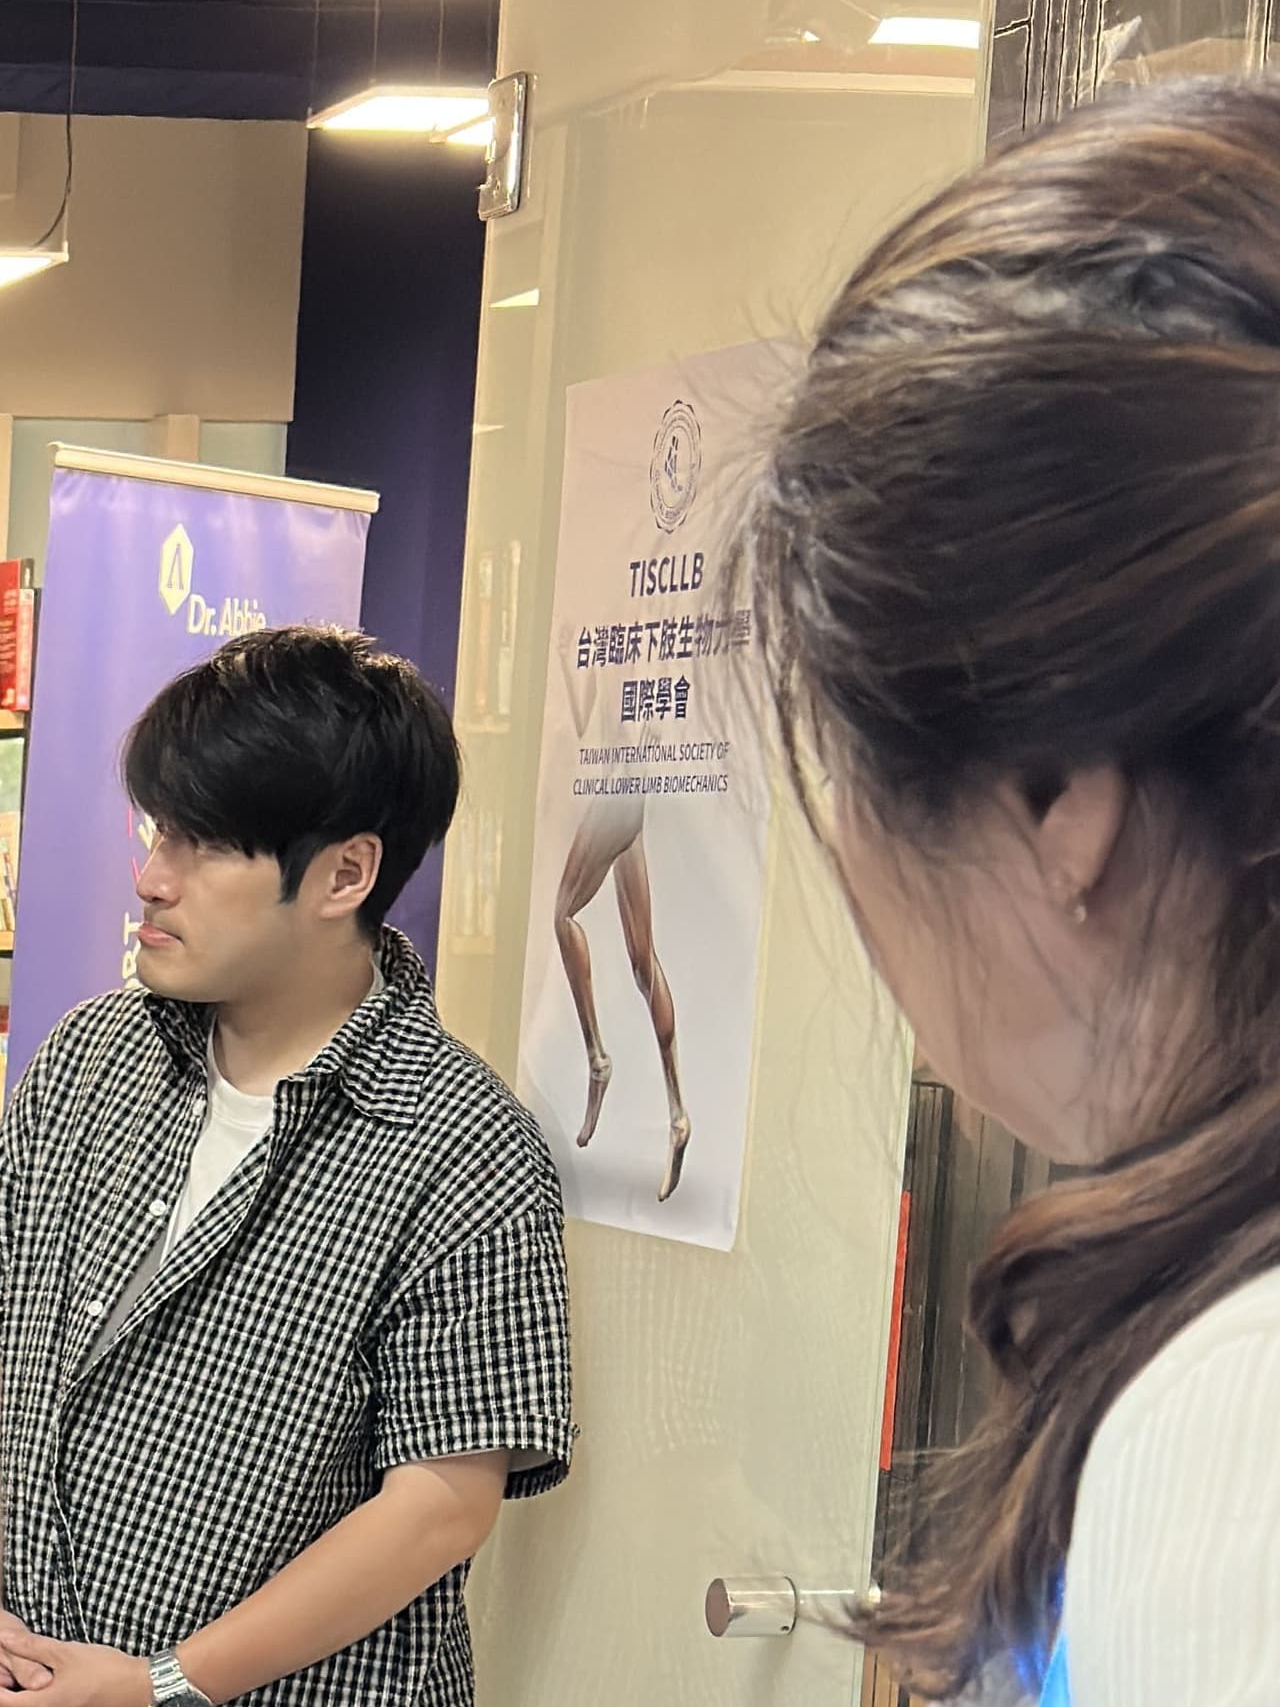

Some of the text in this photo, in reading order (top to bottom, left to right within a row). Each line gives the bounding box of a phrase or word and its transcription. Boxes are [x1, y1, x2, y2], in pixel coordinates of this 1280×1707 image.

[629, 552, 704, 597] TISCLLB
[188, 594, 217, 636] Dr.
[219, 597, 266, 636] Abbie
[621, 675, 690, 723] 國際學會
[579, 748, 610, 765] TAIWAN
[611, 743, 677, 764] INTERNATIONAL
[679, 742, 714, 761] SOCIETY
[573, 774, 728, 795] CLINICAL LOWER LIMB BIOMECHANICS
